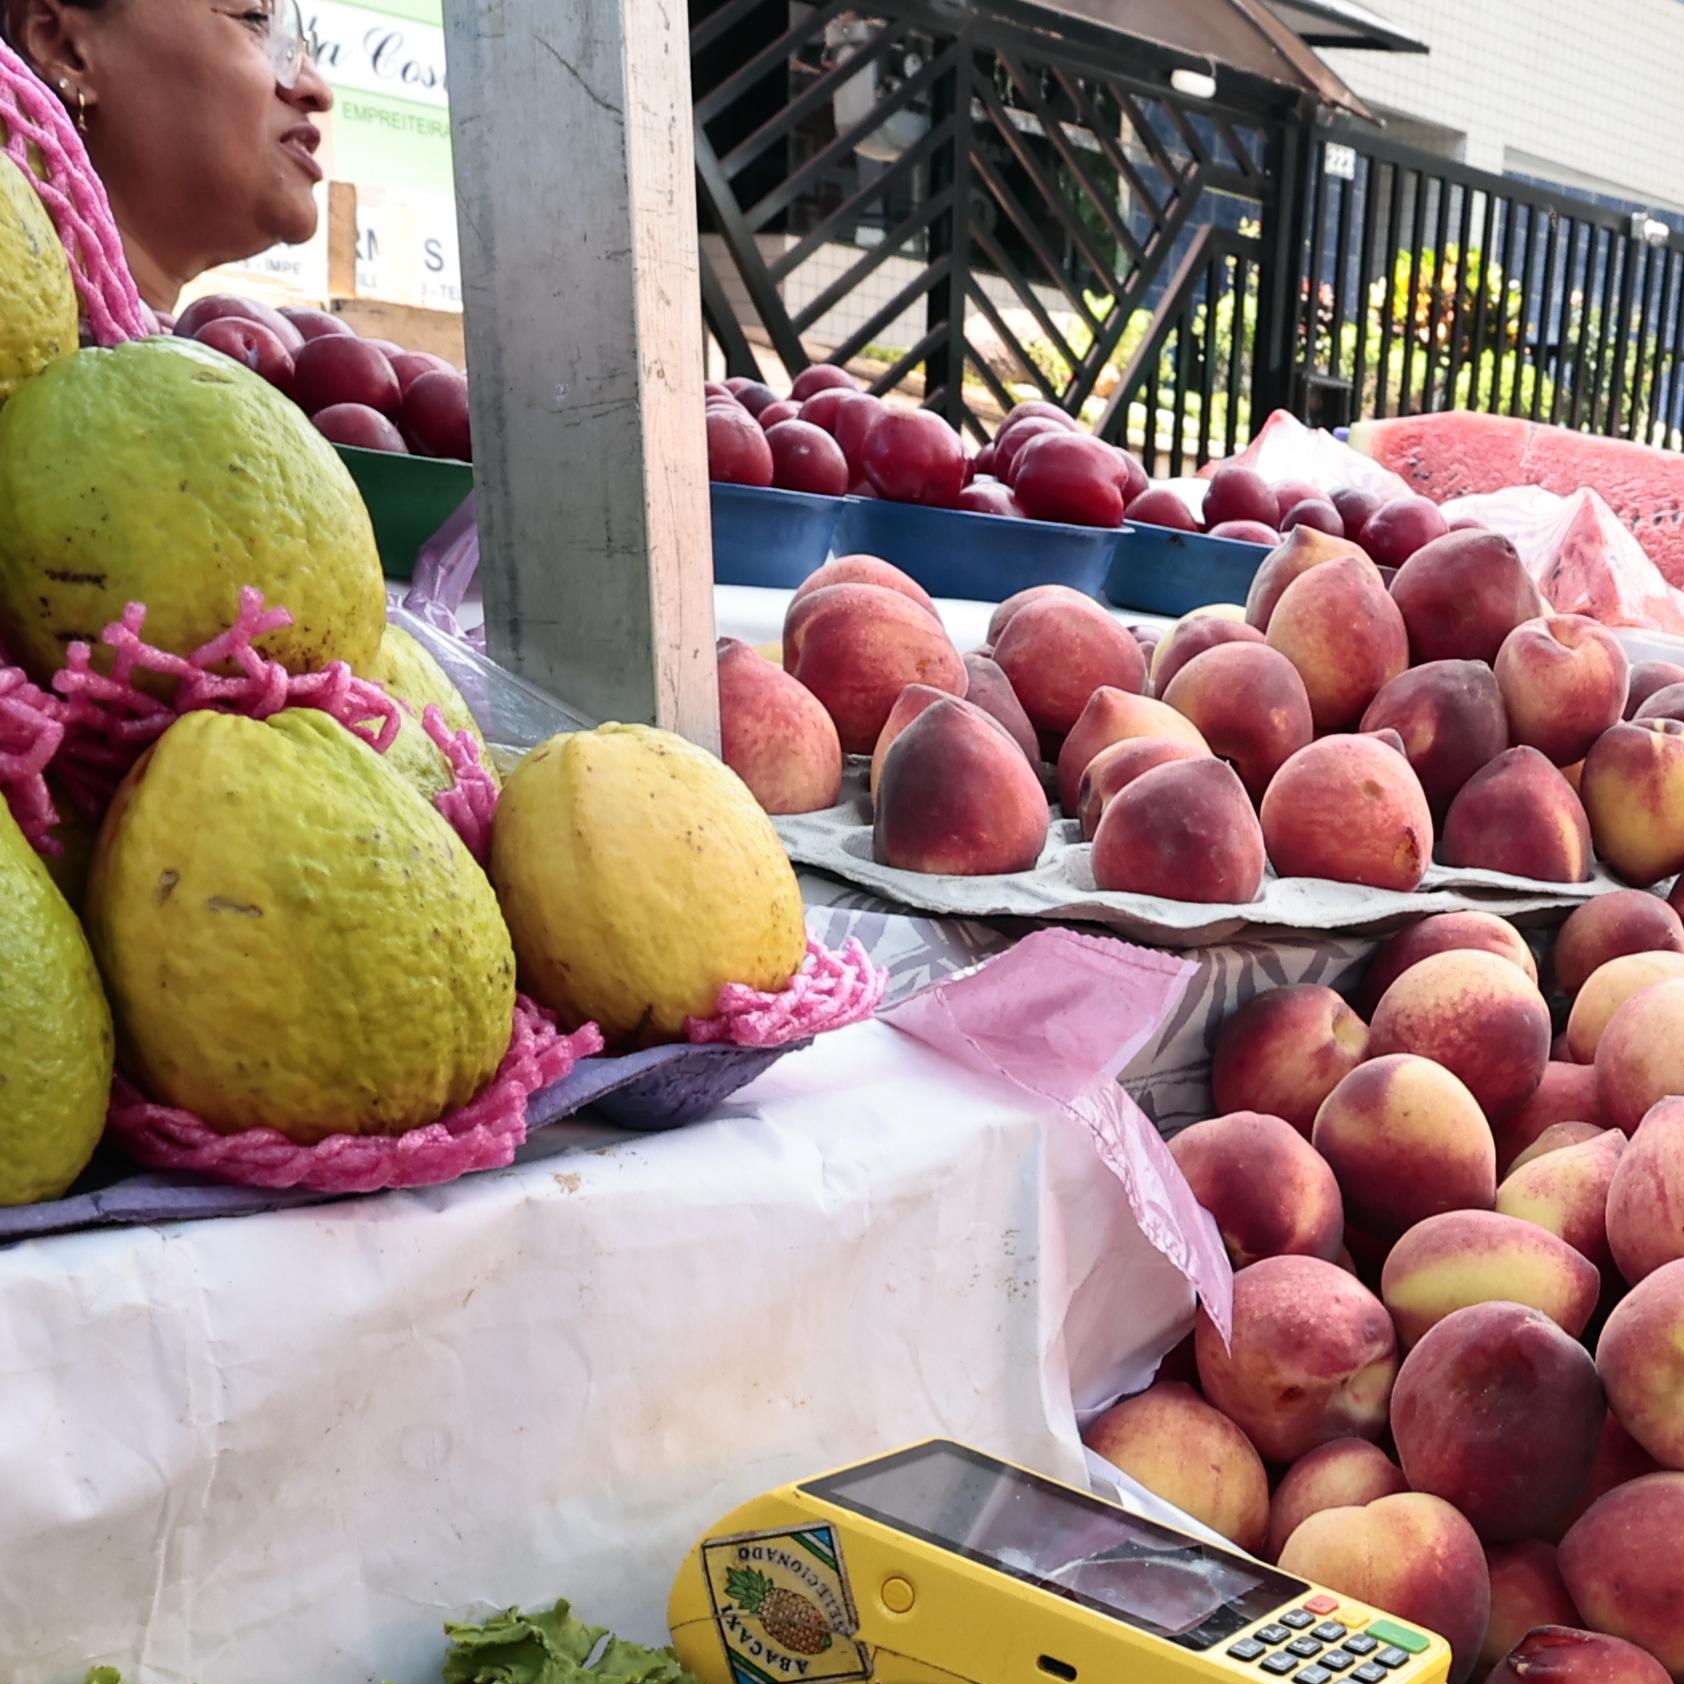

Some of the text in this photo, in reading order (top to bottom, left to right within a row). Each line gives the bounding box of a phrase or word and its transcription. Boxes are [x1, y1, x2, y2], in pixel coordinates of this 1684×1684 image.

[362, 26, 448, 92] Cos
[738, 1547, 845, 1632] SELECIONADO
[721, 1603, 809, 1674] ABACAXI
